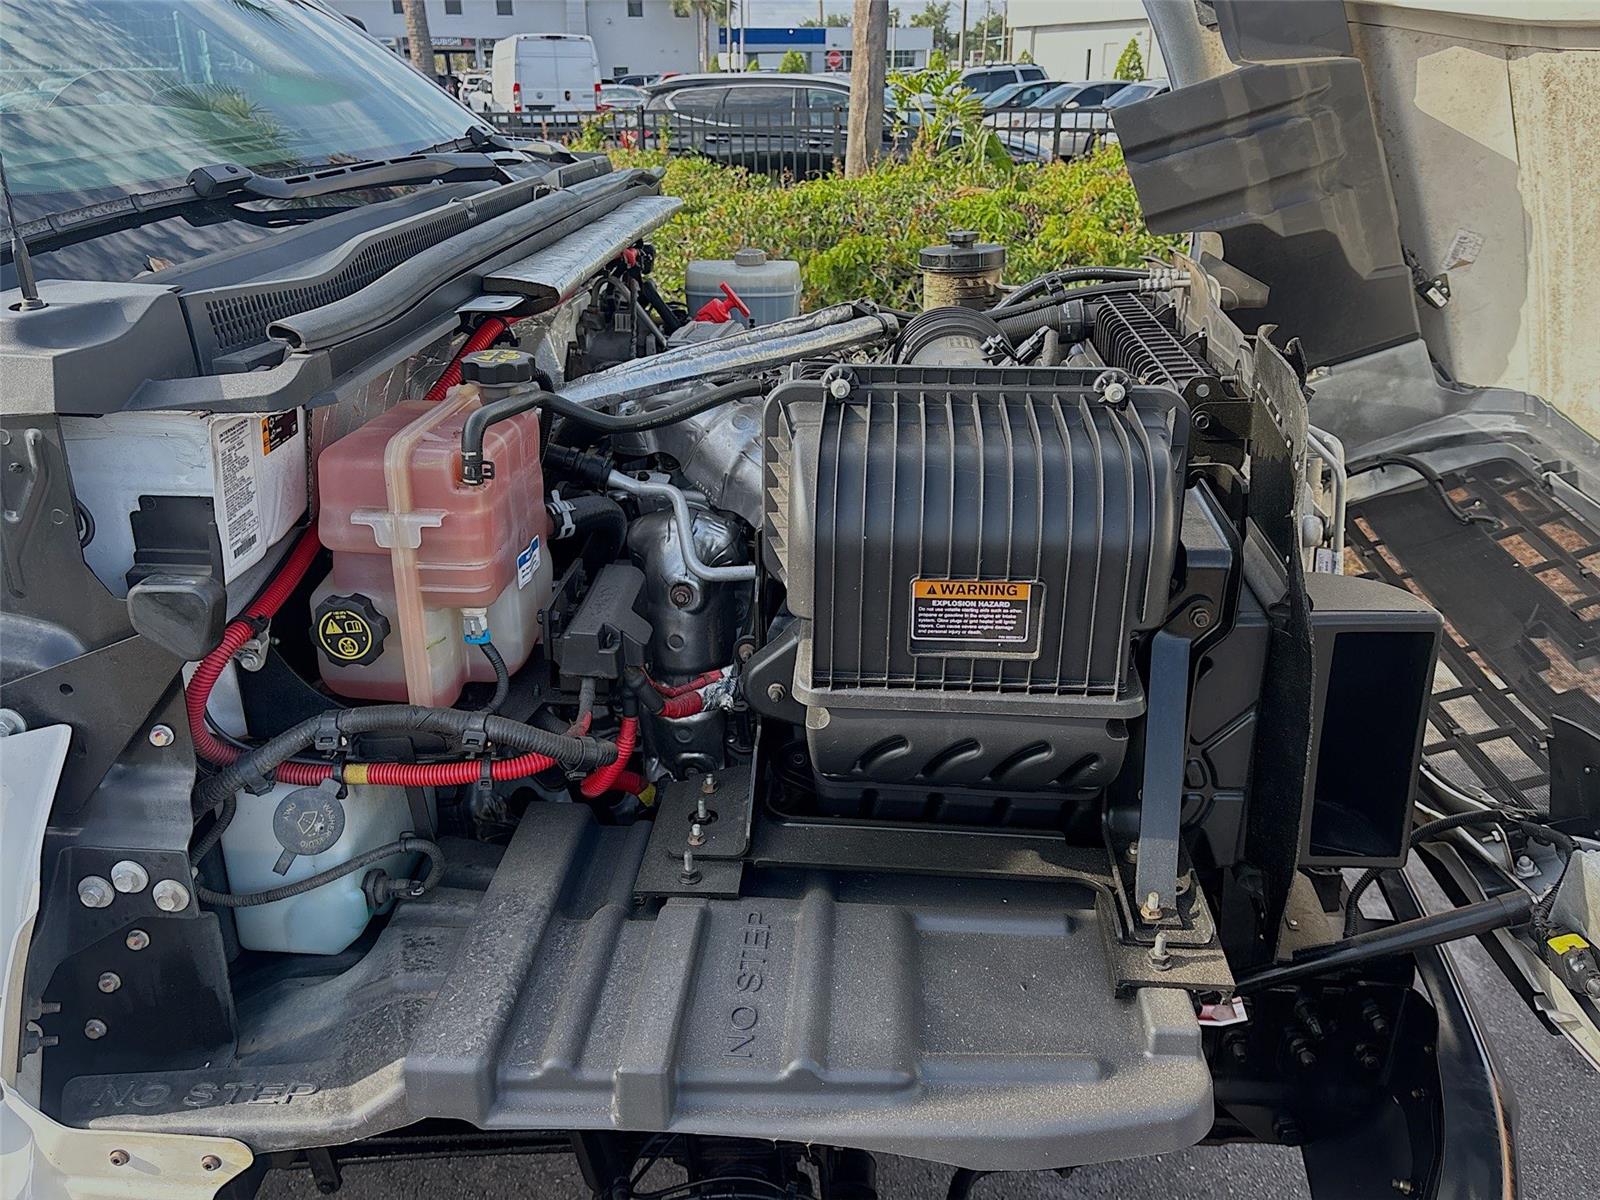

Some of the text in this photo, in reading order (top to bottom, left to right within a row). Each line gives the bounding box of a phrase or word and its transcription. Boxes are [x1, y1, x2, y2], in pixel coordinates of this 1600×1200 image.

[940, 583, 1018, 596] WARNING
[978, 600, 1010, 608] HAZARD
[283, 803, 296, 821] ONLY
[322, 801, 336, 837] WASHER
[723, 911, 772, 1058] NO STEP
[92, 1080, 321, 1108] NO STEP
